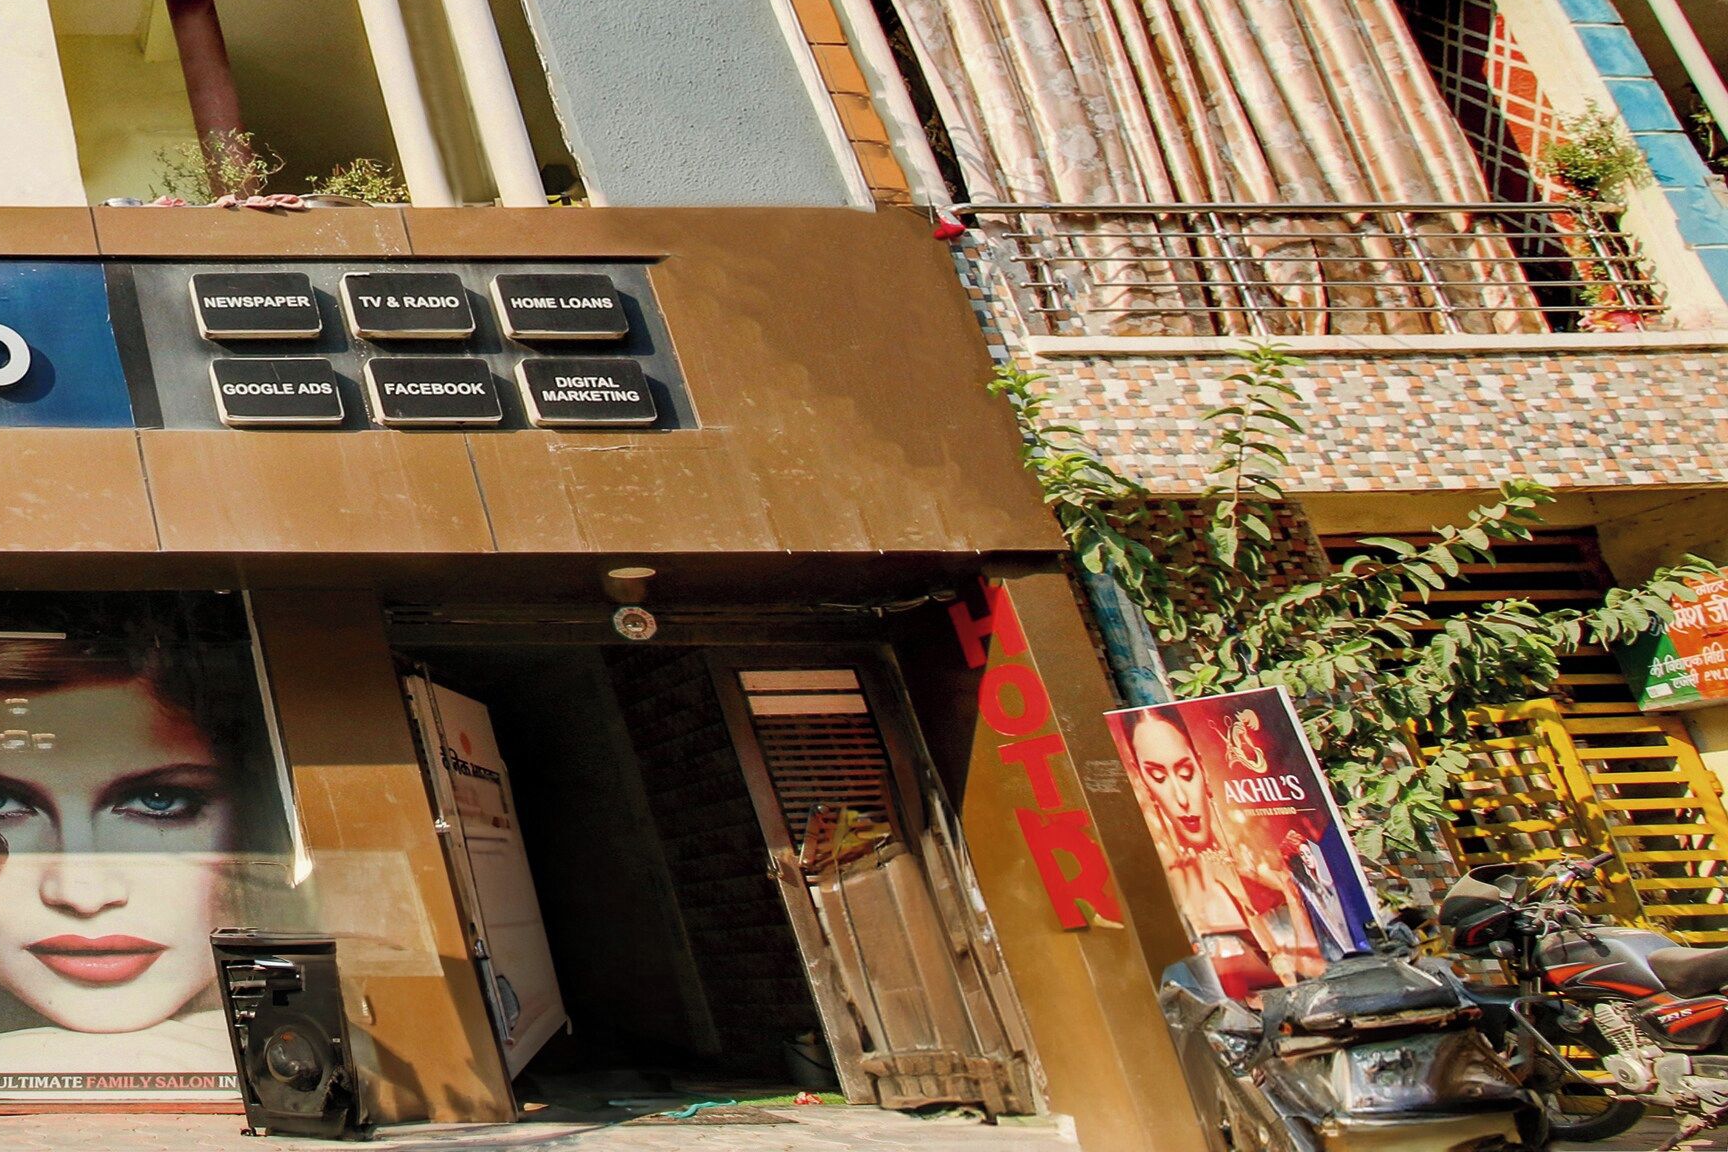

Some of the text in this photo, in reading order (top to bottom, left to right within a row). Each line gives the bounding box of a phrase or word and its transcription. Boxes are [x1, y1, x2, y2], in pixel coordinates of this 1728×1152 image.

[203, 294, 311, 309] NEWSPAPER
[359, 295, 460, 309] TV & RADIO
[510, 296, 613, 309] HOME LOANS
[222, 382, 333, 396] GOOGLE ADS
[384, 382, 486, 396] FACEBOOK
[555, 376, 620, 389] DIGITAL
[542, 389, 641, 403] MARKETING
[1223, 774, 1306, 804] AKHIL'S
[86, 1076, 151, 1089] FAMILY
[155, 1076, 216, 1089] SALON
